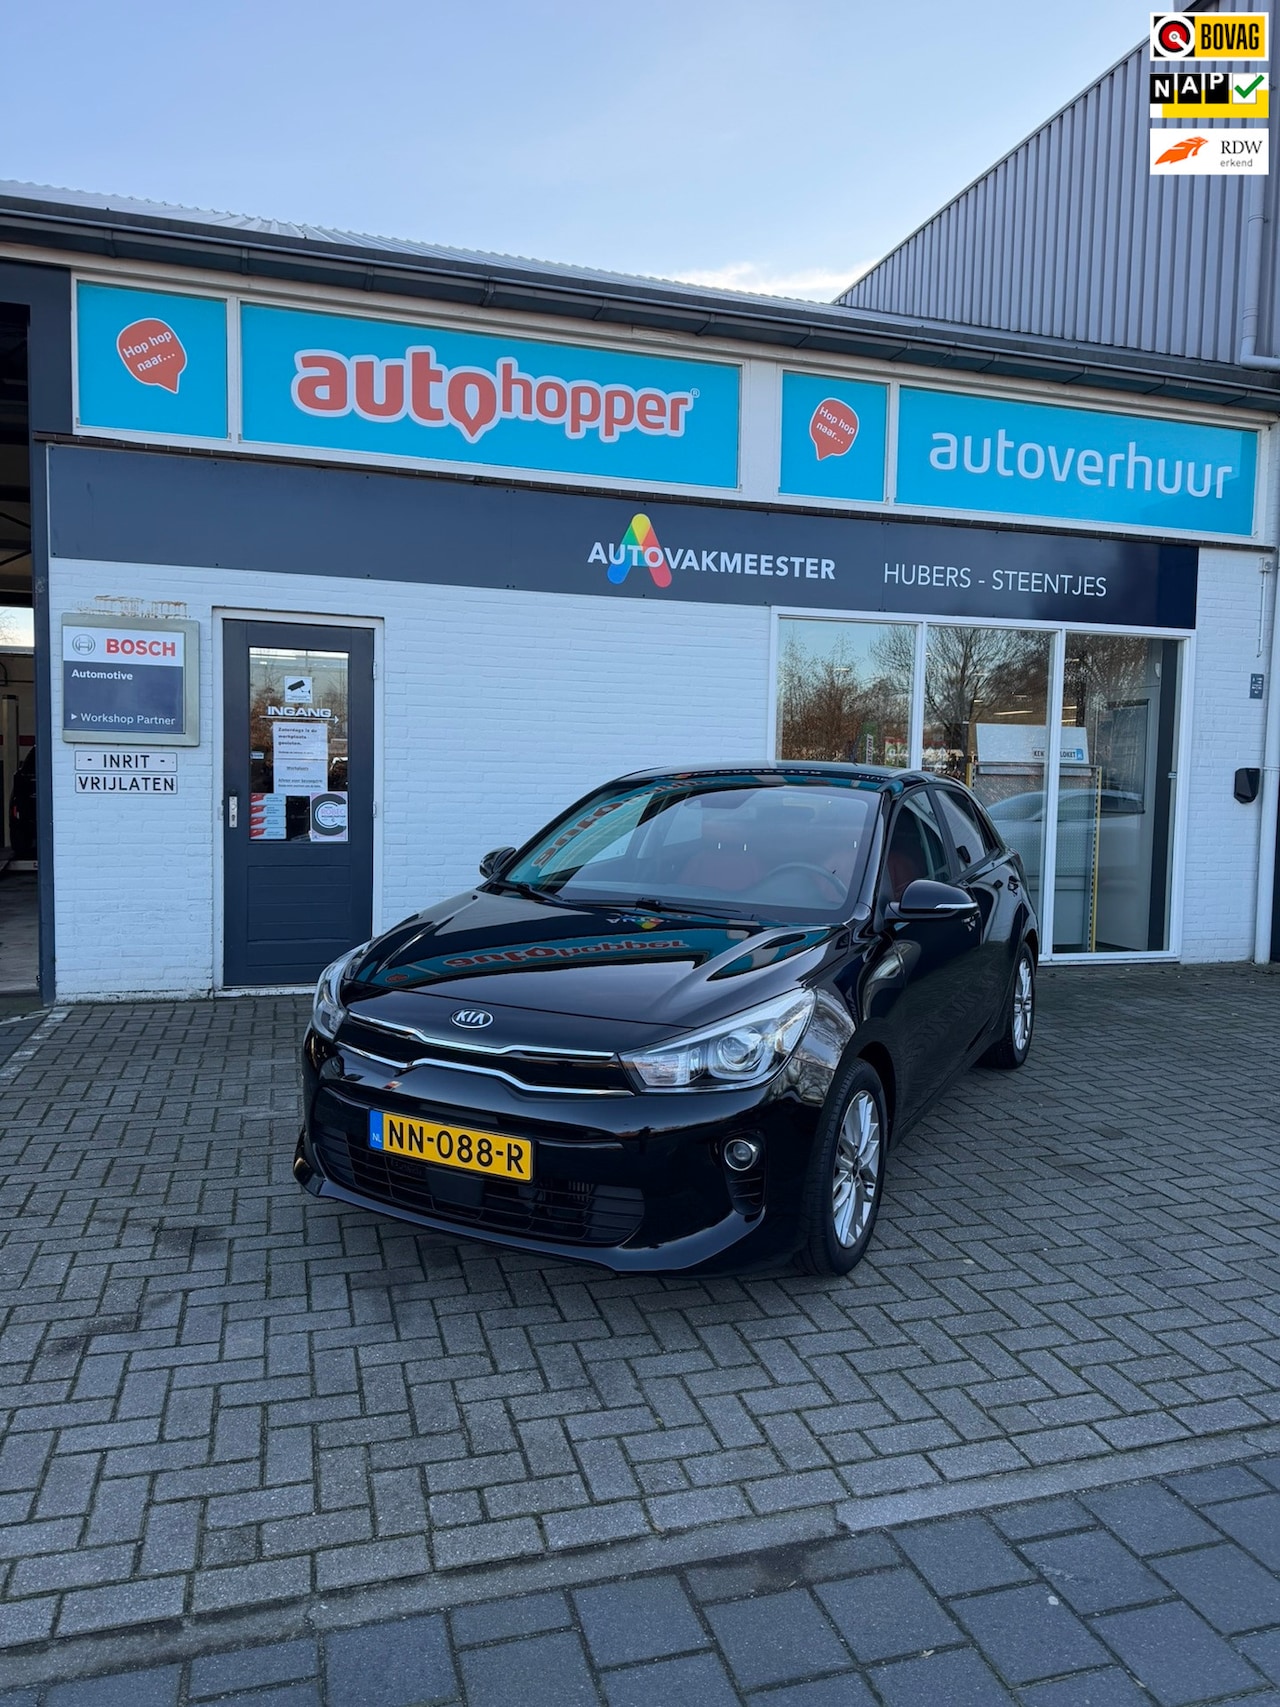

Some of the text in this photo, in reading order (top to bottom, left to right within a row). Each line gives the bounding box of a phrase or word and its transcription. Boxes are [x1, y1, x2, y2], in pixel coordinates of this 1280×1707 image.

[123, 331, 172, 358] Hop hop
[136, 353, 175, 372] naar...
[819, 406, 856, 435] Hop hop
[816, 422, 844, 444] naar...
[929, 428, 1233, 499] autoverhuur
[587, 541, 836, 580] AUTOVAKMEESTER
[883, 562, 972, 590] HUBERS
[991, 569, 1108, 599] STEENTJES
[106, 638, 176, 657] BOSCH
[71, 668, 134, 681] Automotive
[80, 712, 176, 726] Workshop Partner
[267, 706, 332, 718] INGANG
[103, 754, 150, 769] INRIT
[78, 776, 175, 791] VRIJLATEN
[457, 1010, 486, 1025] KIA
[372, 1132, 382, 1143] NL
[388, 1119, 524, 1174] NN-088-R
